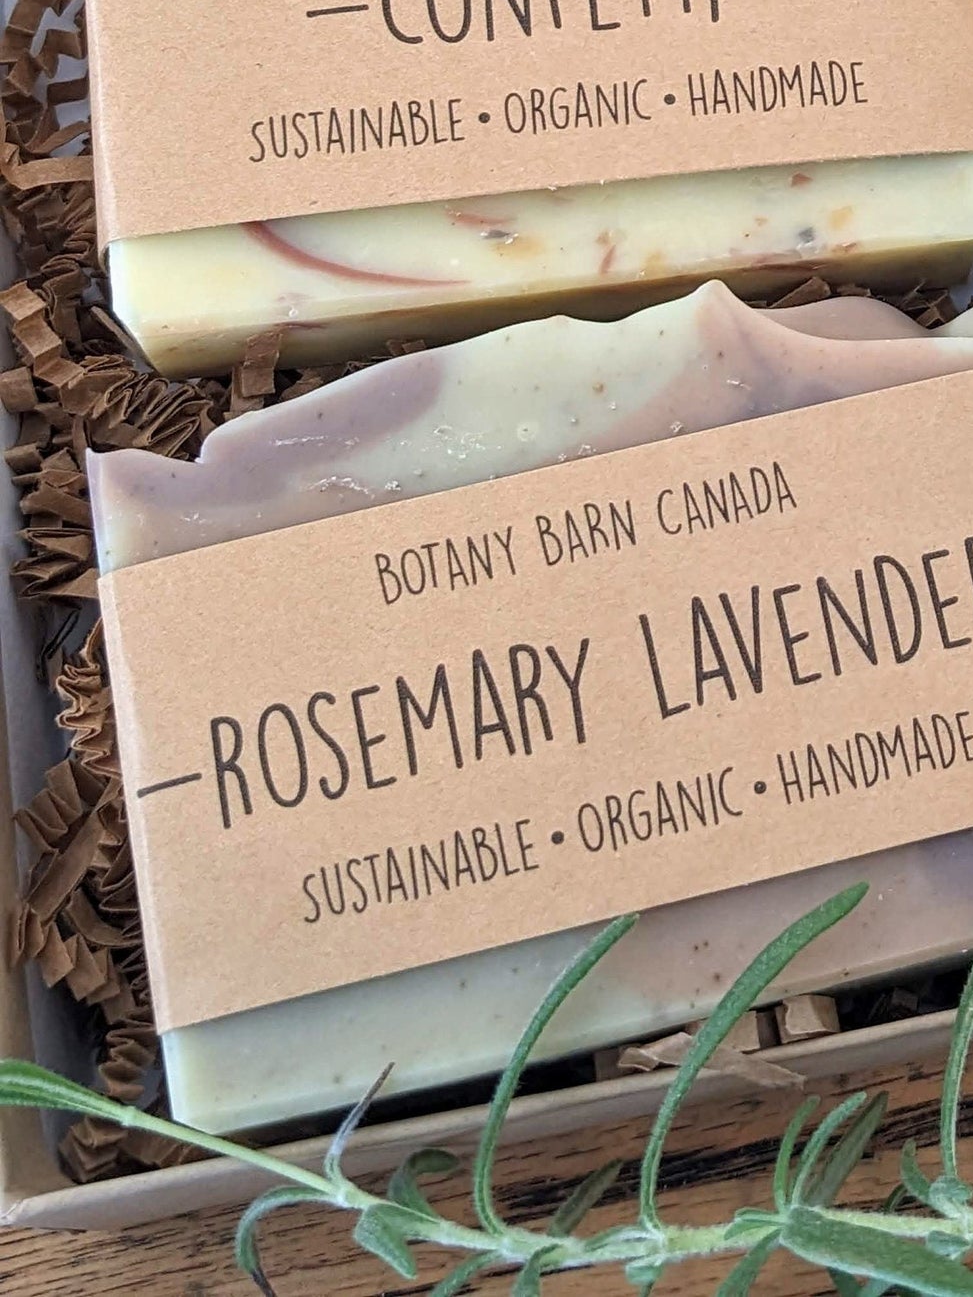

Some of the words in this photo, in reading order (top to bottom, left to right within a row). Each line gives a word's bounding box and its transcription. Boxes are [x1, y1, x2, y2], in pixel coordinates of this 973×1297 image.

[248, 98, 466, 163] SUSTAINABLE
[504, 78, 652, 135] ORGANIC
[687, 60, 869, 117] HANDMADE
[374, 525, 517, 606] BOTANY
[534, 499, 637, 567] BARN
[656, 461, 798, 536] CANADA
[302, 818, 540, 924] SUSTAINABLE
[577, 766, 744, 853] ORGANIC
